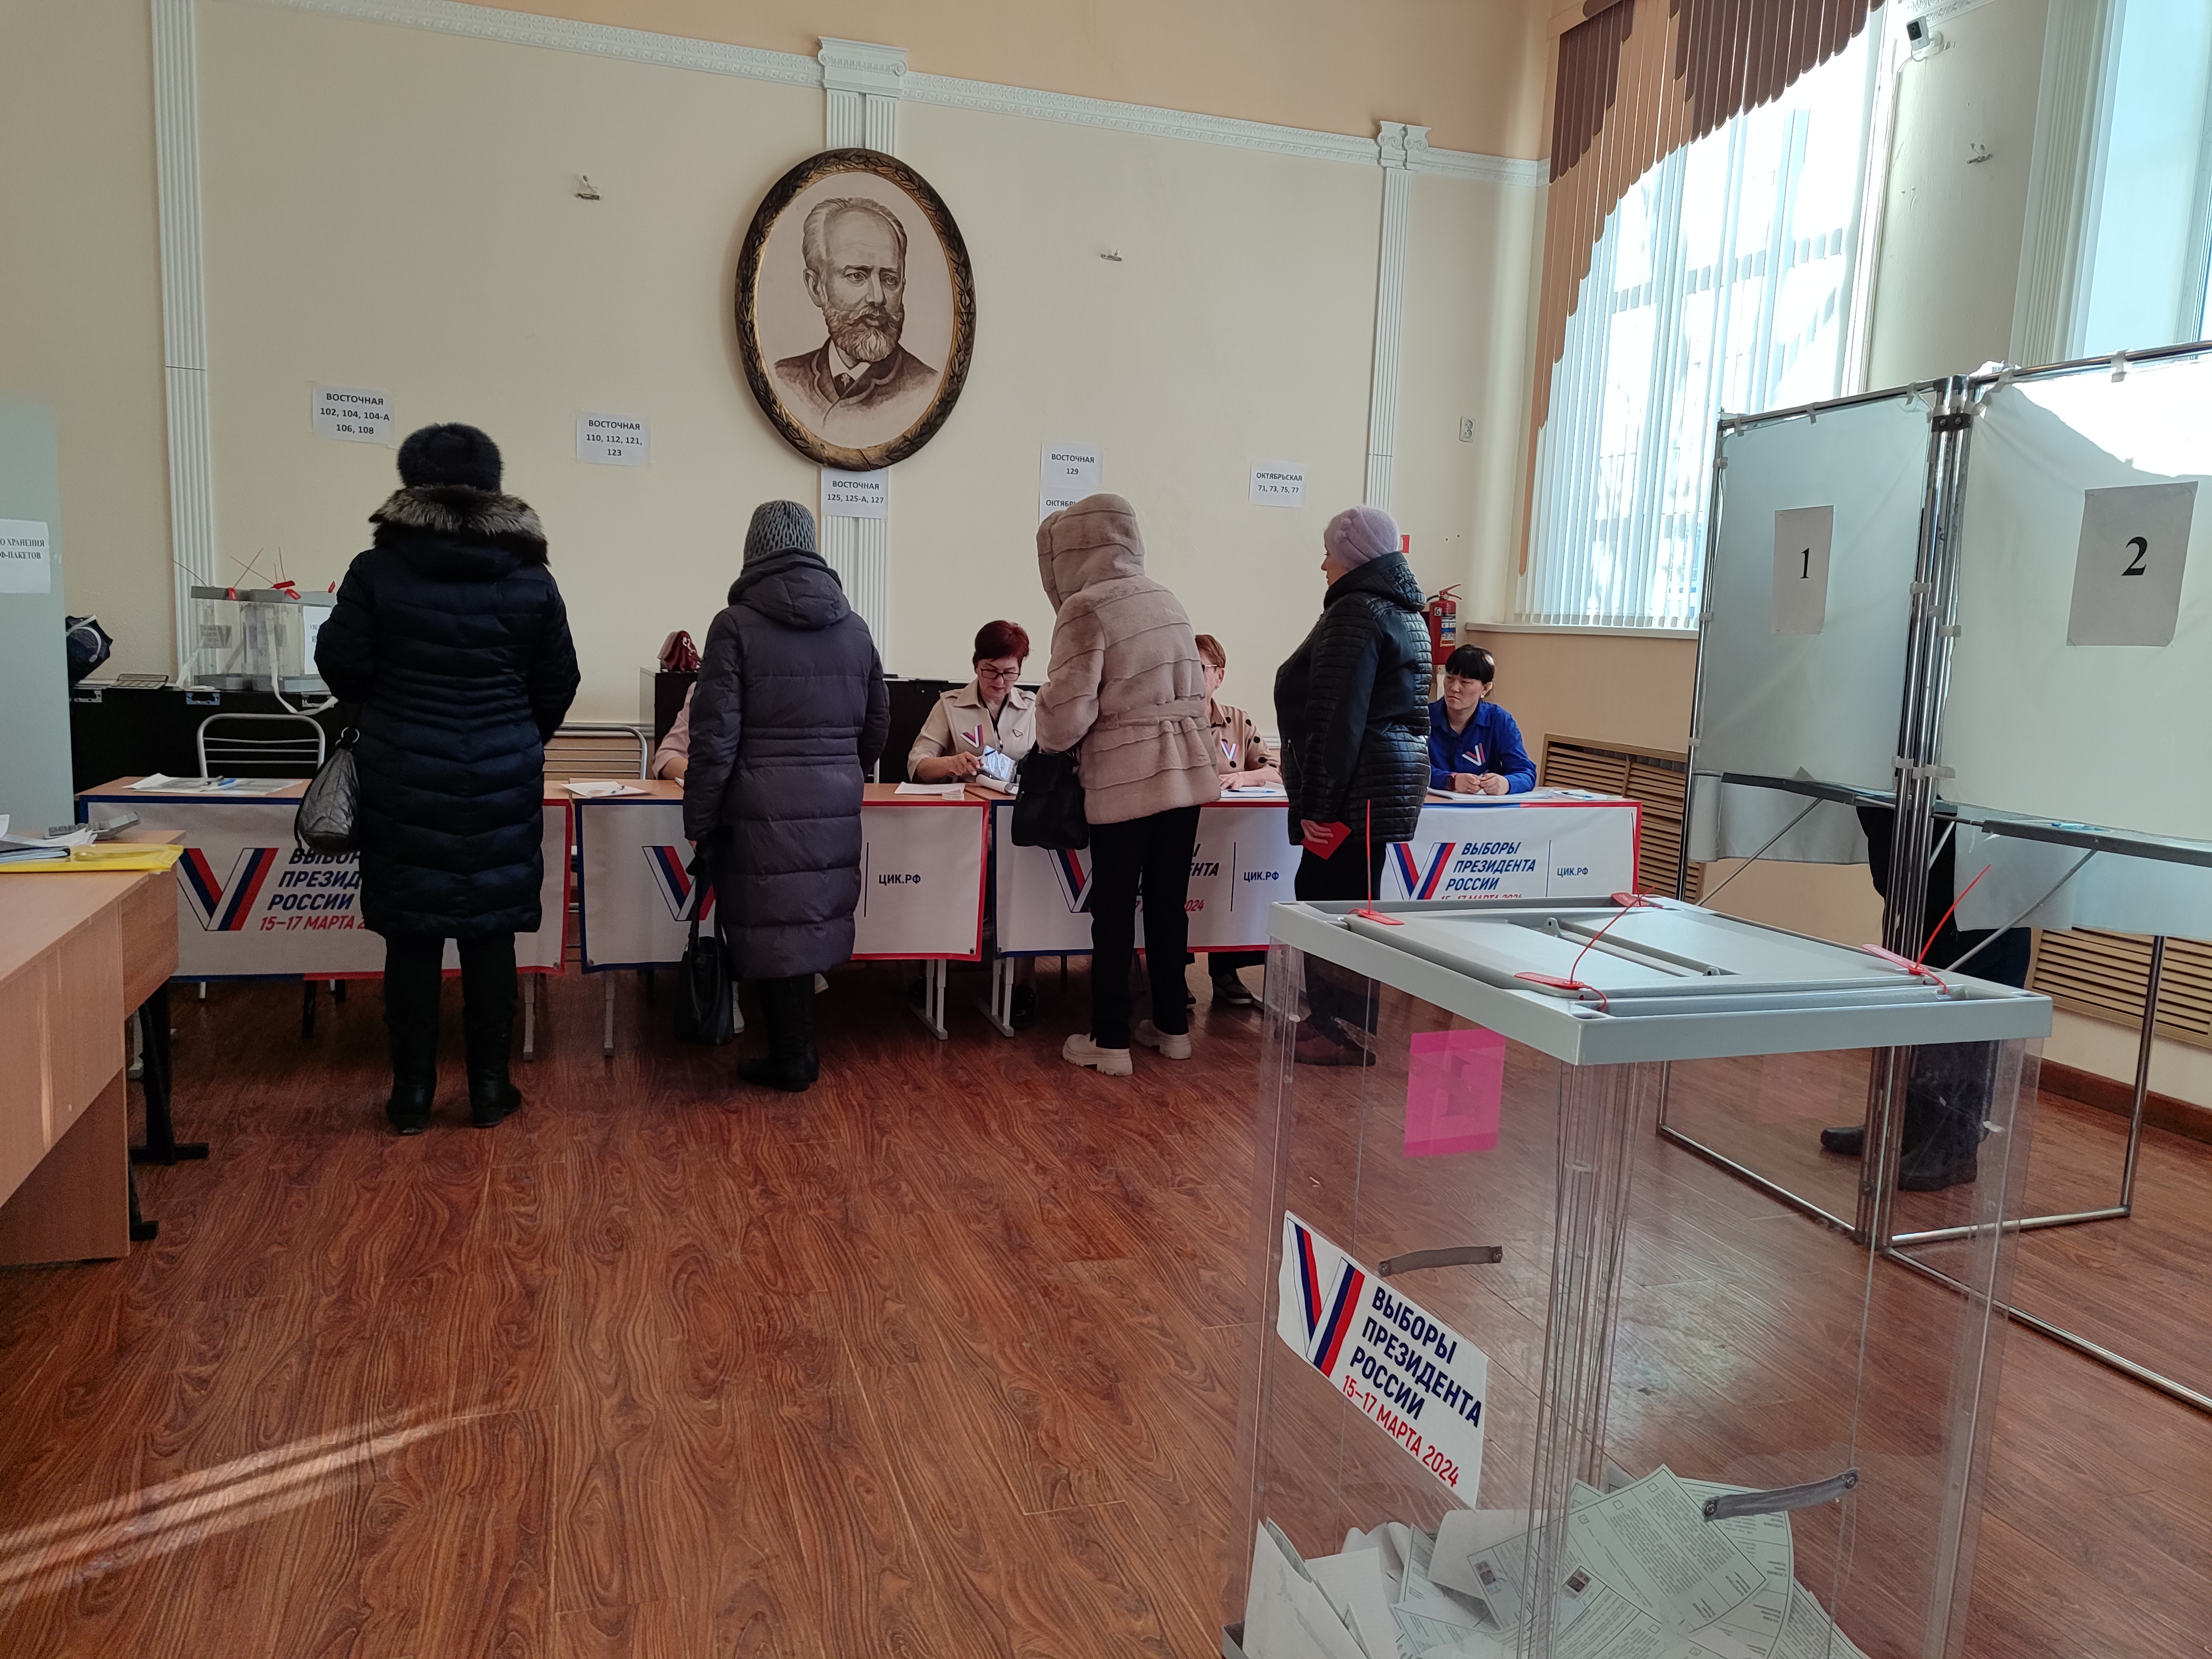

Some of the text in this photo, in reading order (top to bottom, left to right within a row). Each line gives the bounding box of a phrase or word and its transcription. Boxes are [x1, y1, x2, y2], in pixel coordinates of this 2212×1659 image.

[326, 393, 384, 406] ВОСТОЧНАЯ
[320, 408, 390, 421] 102, 104, 104-А
[336, 424, 374, 435] 106, 108
[588, 420, 640, 430] ВОСТОЧНАЯ
[586, 434, 643, 446] 110, 112, 121,
[1051, 453, 1094, 463] ВОСТОЧНАЯ
[1256, 472, 1302, 482] ОКТЯБРЬСКАЯ
[832, 481, 879, 490] ВОСТОЧНАЯ
[1258, 484, 1267, 493] 71,
[1269, 485, 1279, 493] 73,
[827, 494, 843, 502] 125,
[7, 538, 45, 547] ХРАНЕНИЯ
[2121, 536, 2148, 576] 2
[1799, 547, 1810, 579] 1
[1461, 842, 1522, 855] ВЫБОРЫ
[289, 848, 361, 864] ВЫБОР
[1453, 859, 1536, 874] ПРЕЗИДЕНТА
[1557, 867, 1589, 878] ЦИК.РФ
[278, 871, 360, 890] ПРЕЗИД
[879, 874, 921, 886] ЦИК.РФ
[1244, 871, 1279, 883] ЦИК.РФ
[1444, 877, 1500, 891] РОССИИ
[267, 894, 355, 911] РОССИИ
[1185, 900, 1204, 912] 024
[304, 915, 355, 930] МАРТА
[1371, 1286, 1457, 1364] ВЫБОРЫ
[1361, 1316, 1483, 1428] ПРЕЗИДЕНТА
[1349, 1345, 1426, 1420] РОССИИ
[1376, 1404, 1422, 1457] МАРТА
[1422, 1445, 1459, 1488] 2024
